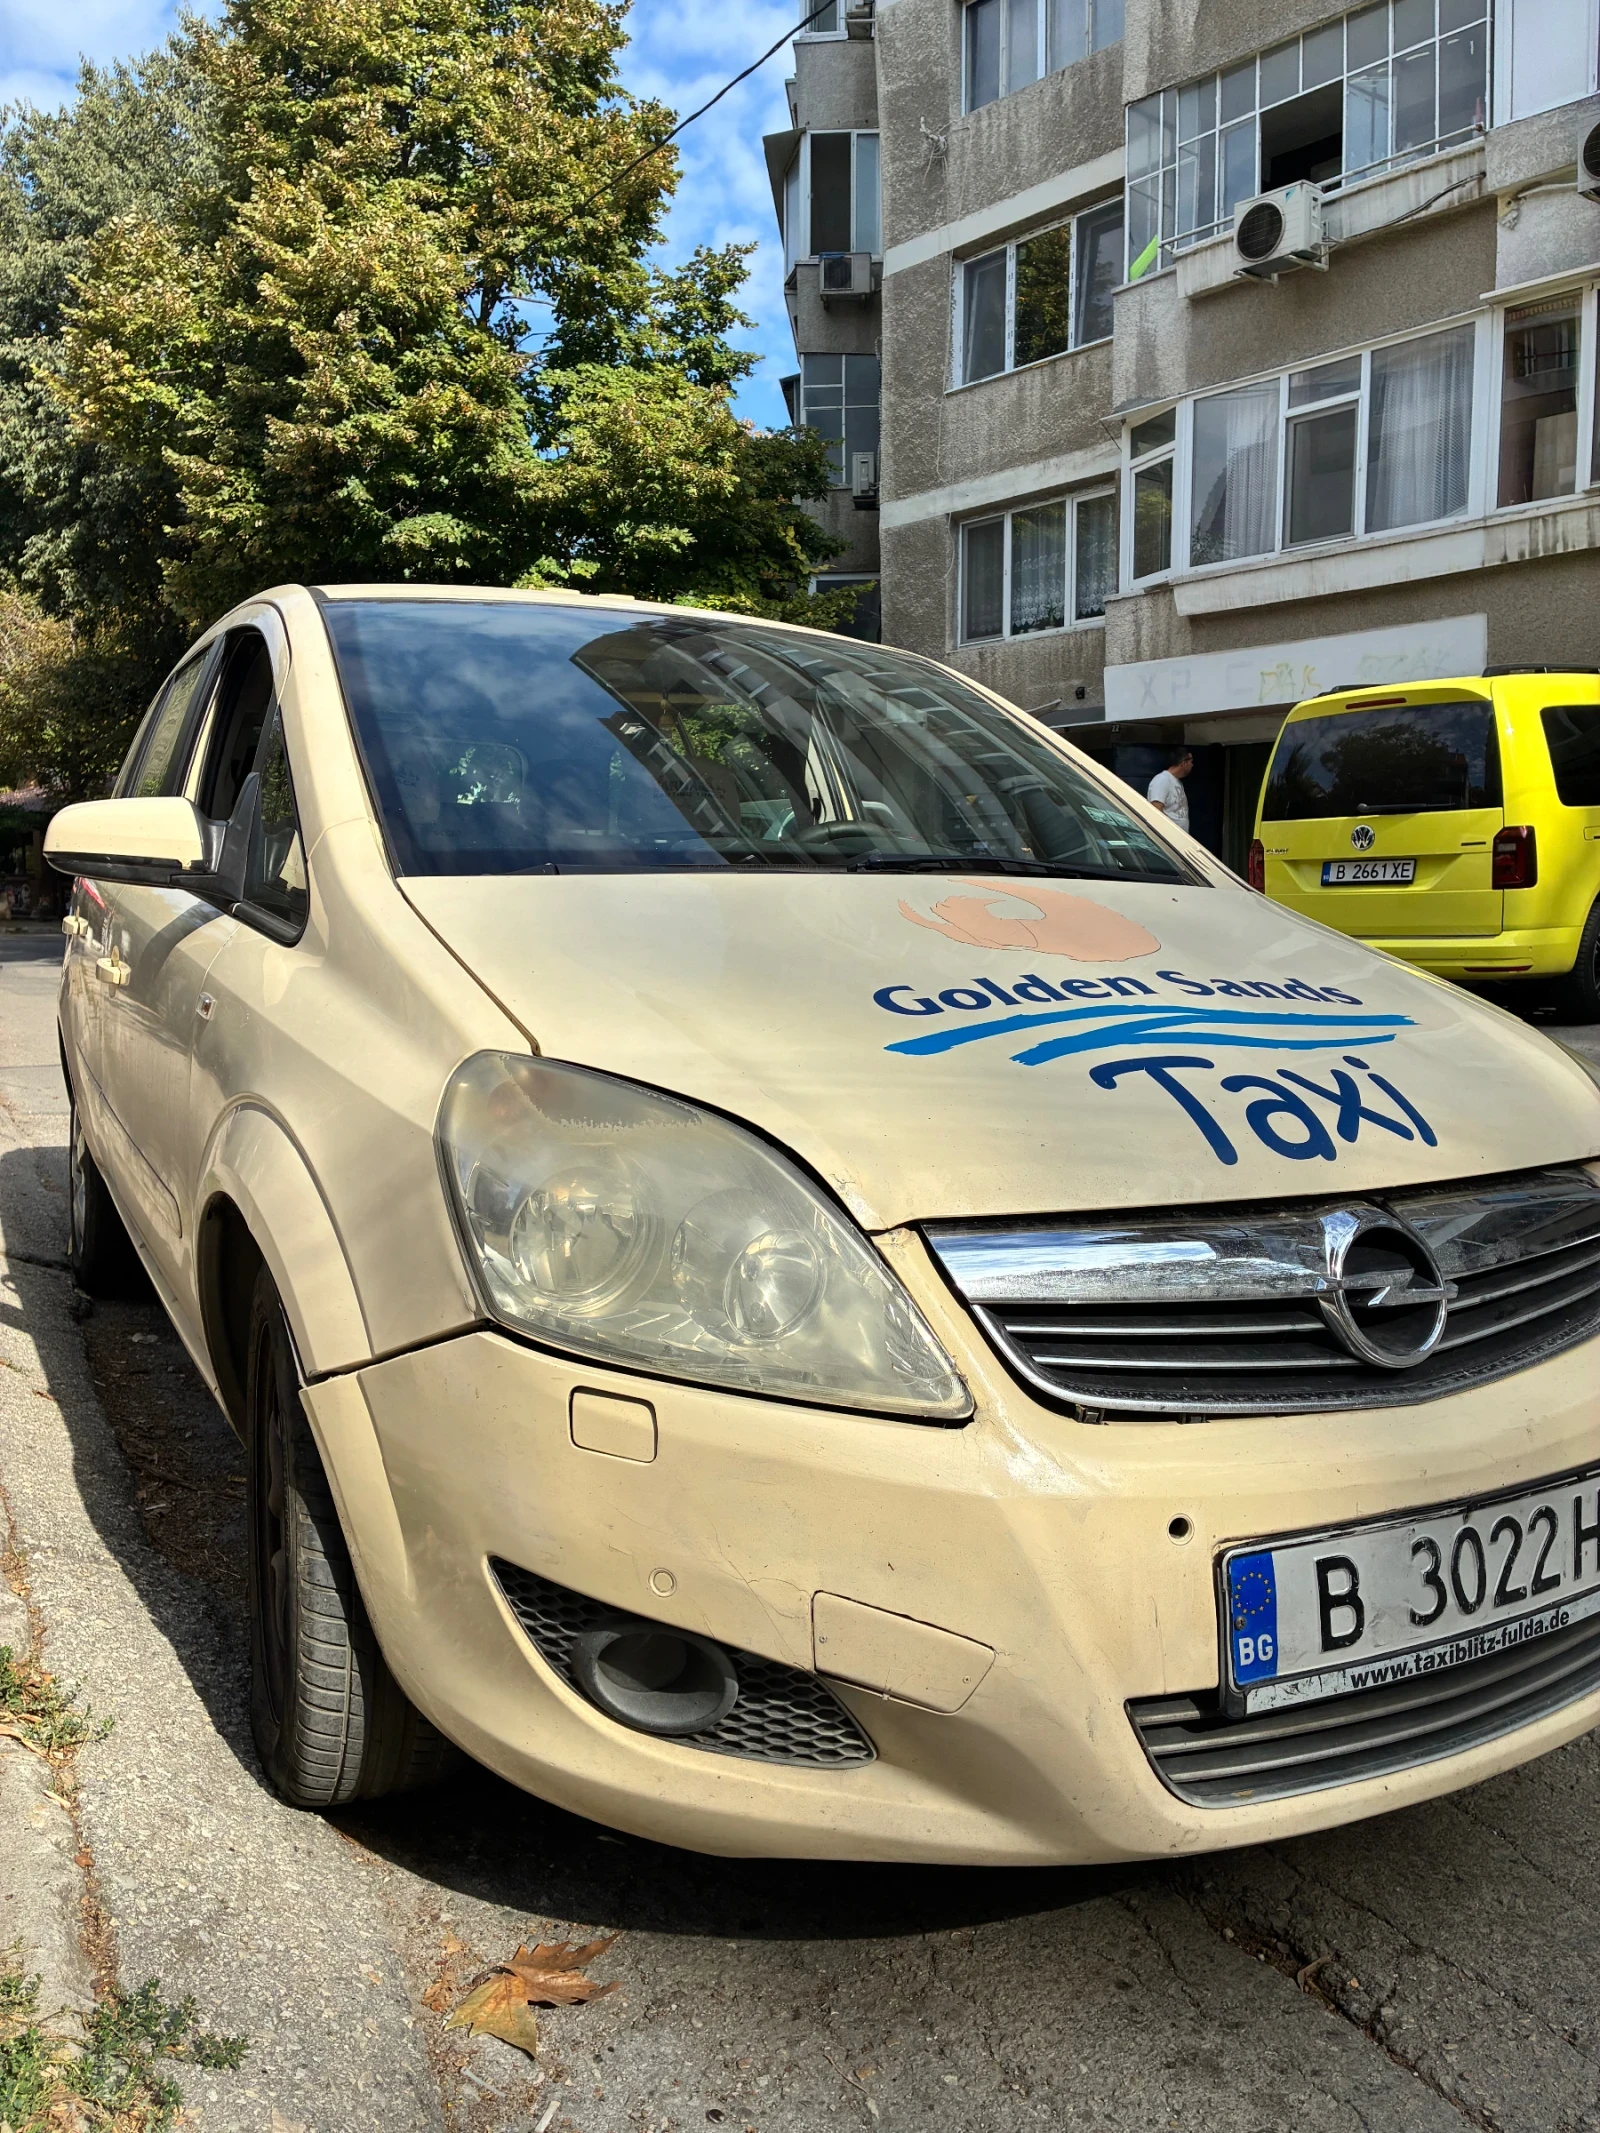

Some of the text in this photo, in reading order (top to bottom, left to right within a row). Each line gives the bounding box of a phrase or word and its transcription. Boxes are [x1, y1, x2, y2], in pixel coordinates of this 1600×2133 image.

[1336, 864, 1346, 880] B
[873, 970, 1364, 1017] Golden Sands
[1089, 1055, 1438, 1166] Taxi
[1313, 1553, 1366, 1653] B
[1238, 1633, 1274, 1667] BG
[1351, 1608, 1571, 1689] www.taxiblitz-fulda.de
